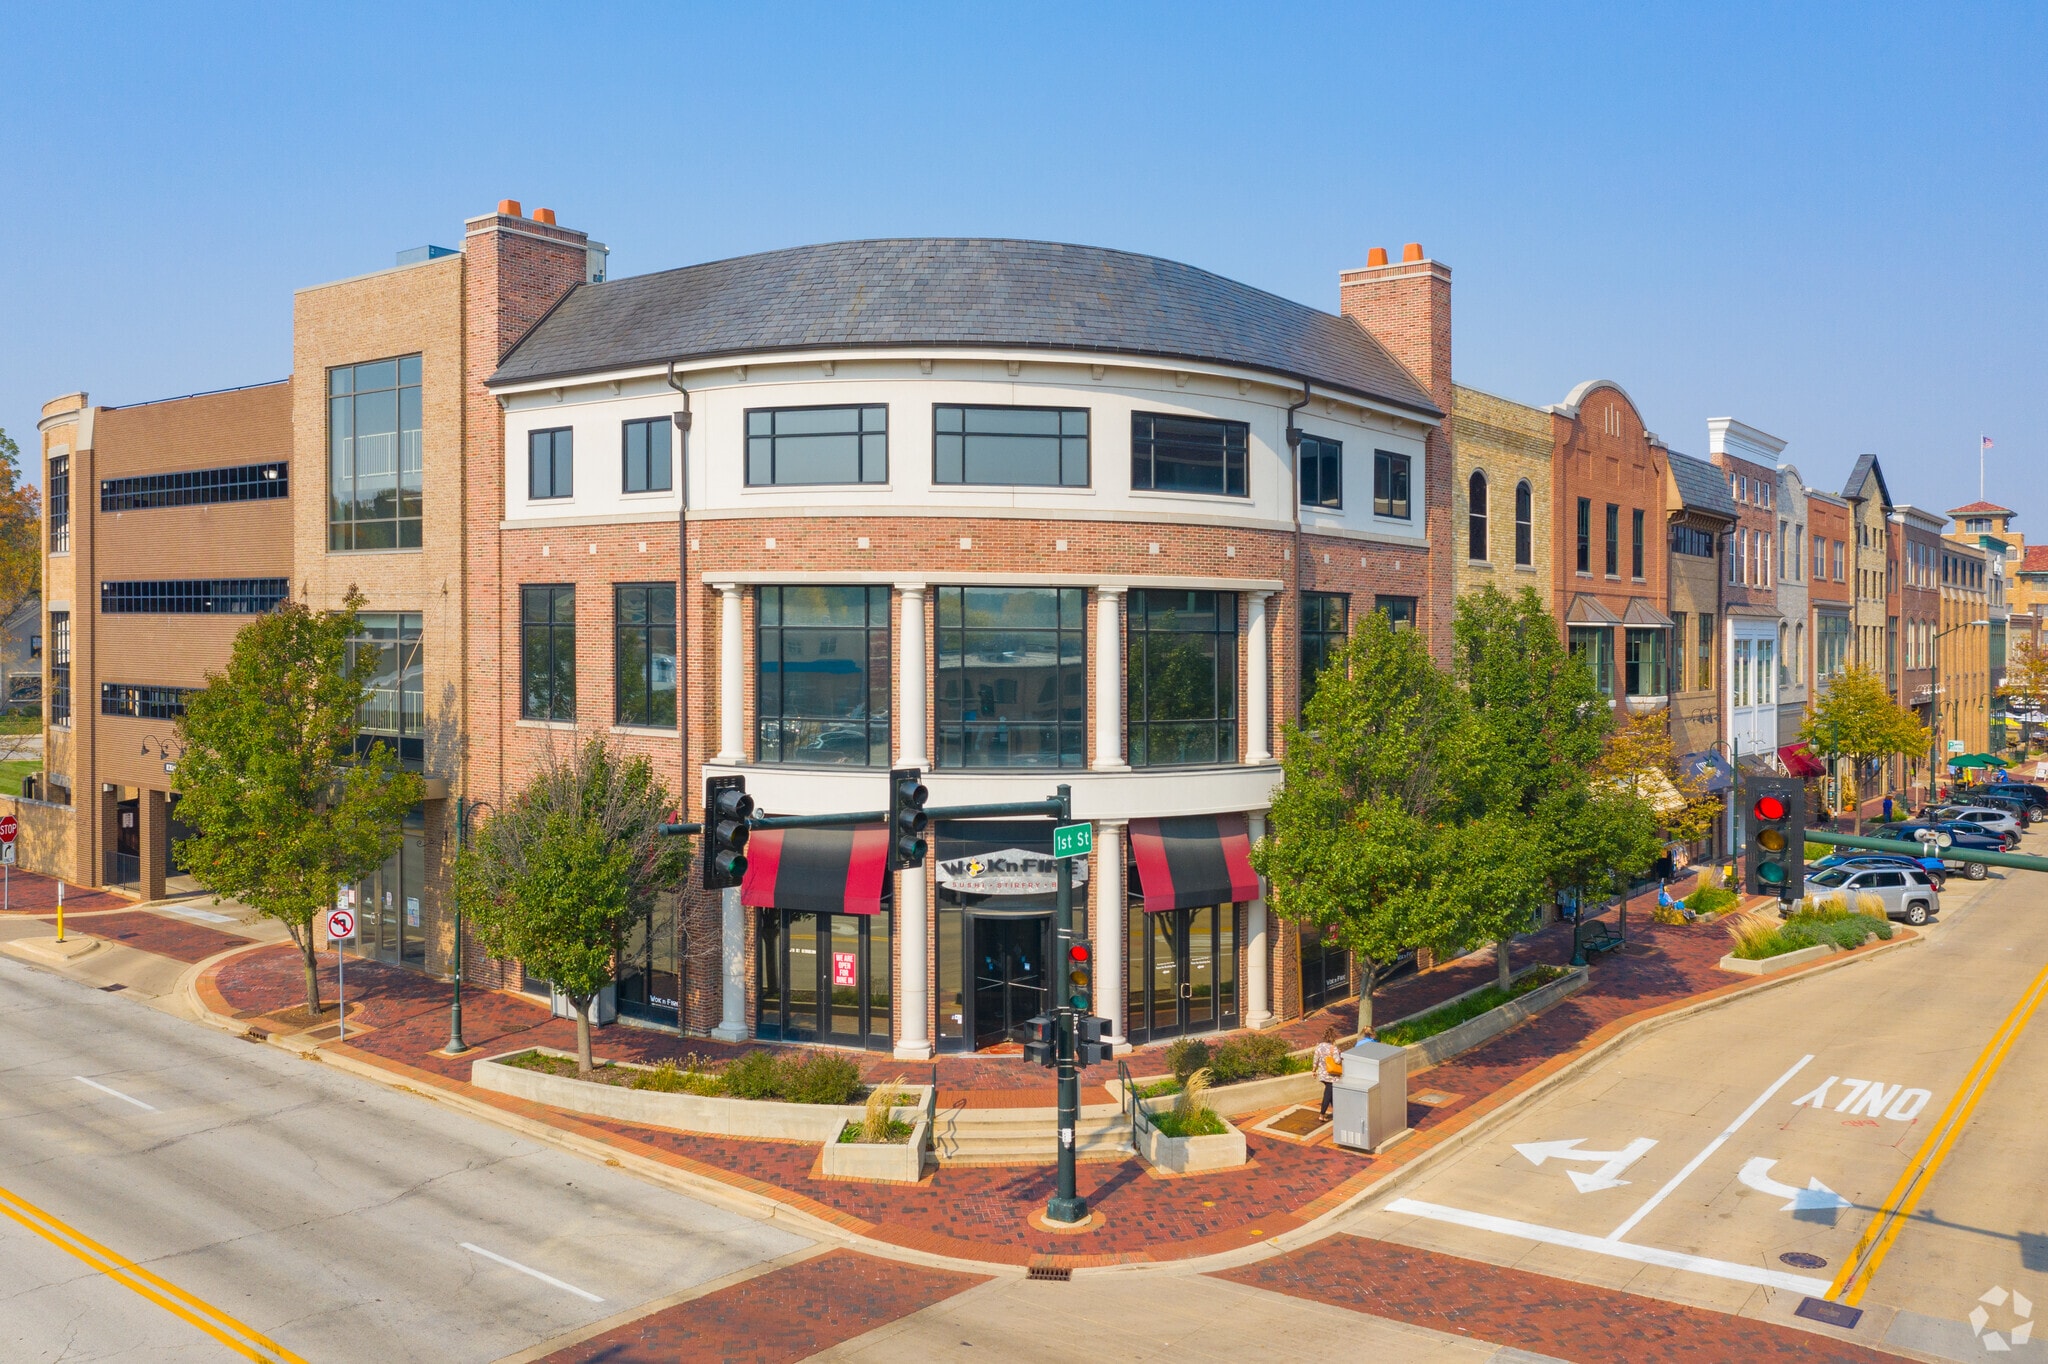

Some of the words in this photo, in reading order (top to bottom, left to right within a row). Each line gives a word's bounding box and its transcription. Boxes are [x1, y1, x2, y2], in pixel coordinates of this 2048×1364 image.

[0, 823, 17, 835] STOP
[1057, 834, 1072, 851] 1st
[1077, 831, 1090, 847] St
[996, 881, 1040, 889] STIRFRY
[836, 954, 844, 962] WE
[844, 954, 854, 963] ARE
[838, 961, 851, 970] OPEN
[839, 969, 849, 977] FOR
[836, 976, 847, 984] DINE
[1791, 1075, 1932, 1121] ONLY
